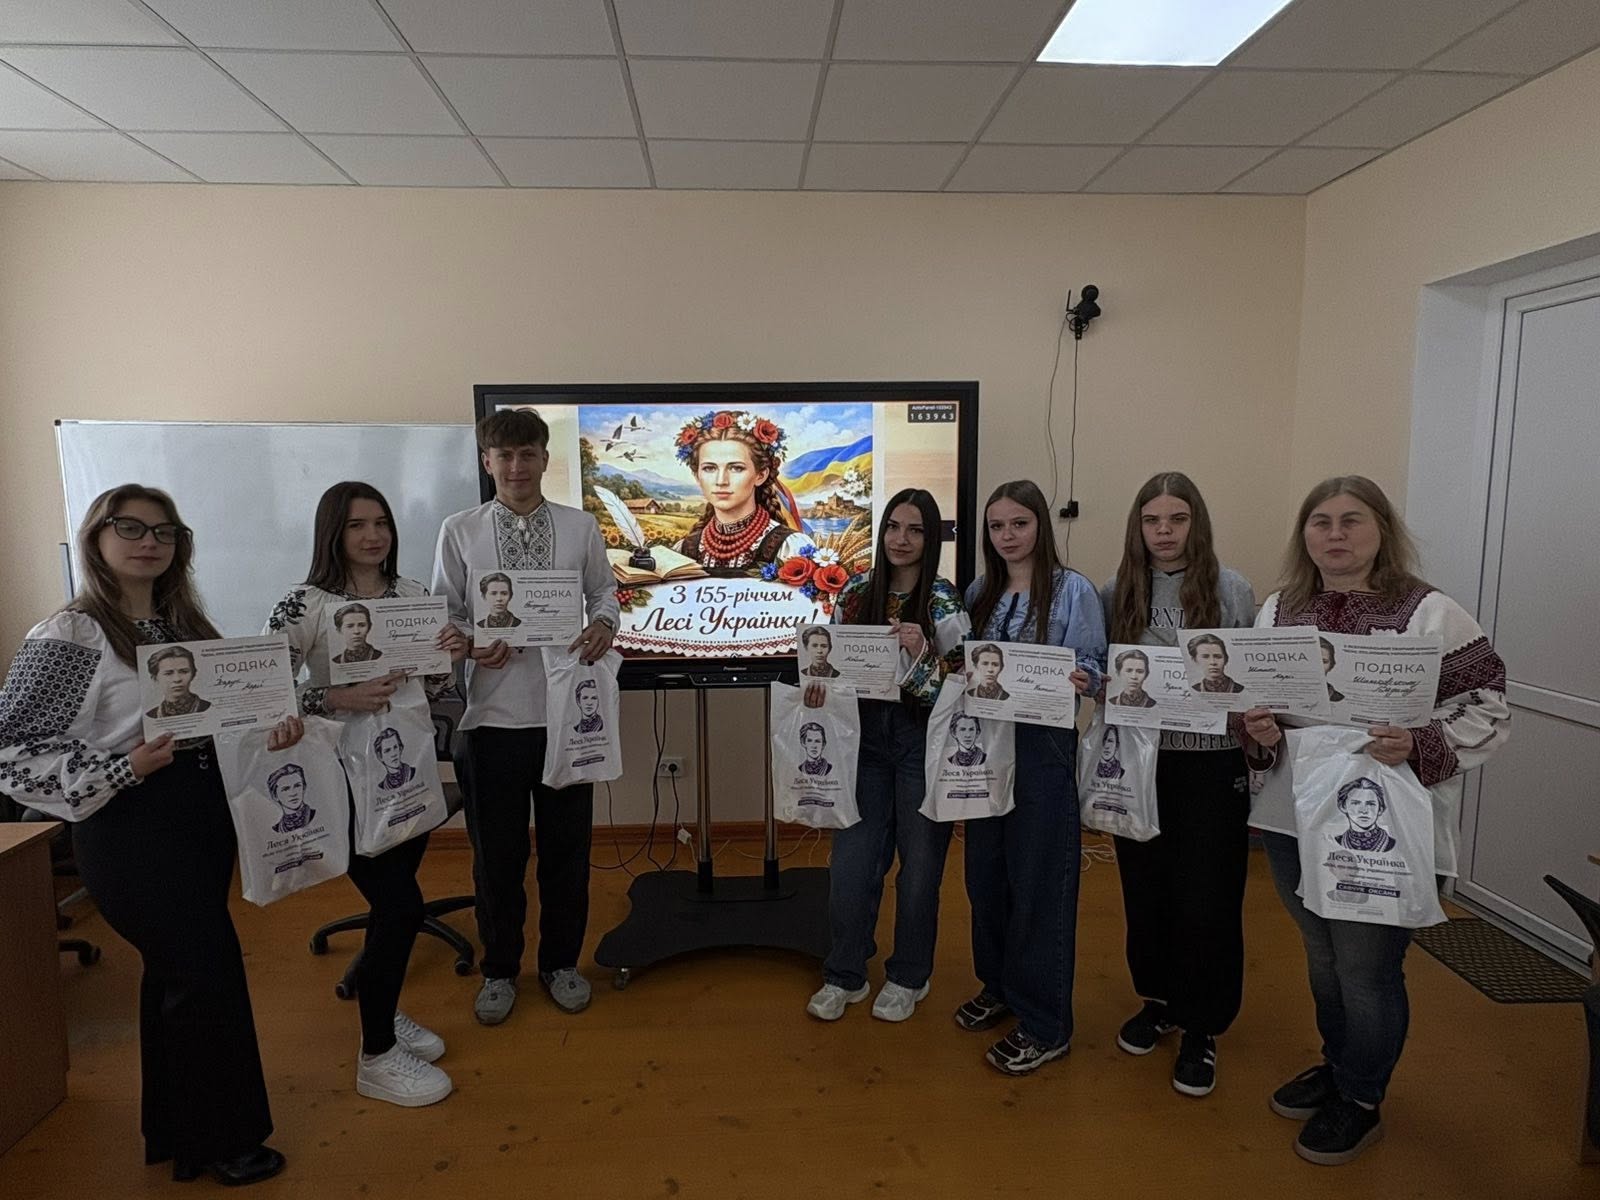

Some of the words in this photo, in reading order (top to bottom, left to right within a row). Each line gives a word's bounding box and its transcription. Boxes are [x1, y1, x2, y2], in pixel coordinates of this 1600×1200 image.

[525, 590, 572, 599] ПОДЯКА
[669, 585, 687, 604] З
[695, 586, 793, 608] 155-річчям
[385, 616, 438, 628] ПОДЯКА
[631, 607, 693, 632] Лесі
[699, 606, 819, 638] Українки!
[843, 644, 890, 654] ПОДЯКА
[1244, 652, 1309, 662] ПОДЯКА
[214, 658, 279, 674] ПОДЯКА
[1016, 663, 1065, 676] ПОДЯКА
[1354, 661, 1426, 675] ПОДЯКА
[1163, 670, 1187, 680] ПОД
[942, 769, 960, 777] Леся
[266, 836, 289, 850] Леся
[1327, 851, 1354, 863] Леся
[1356, 854, 1406, 868] Українка
